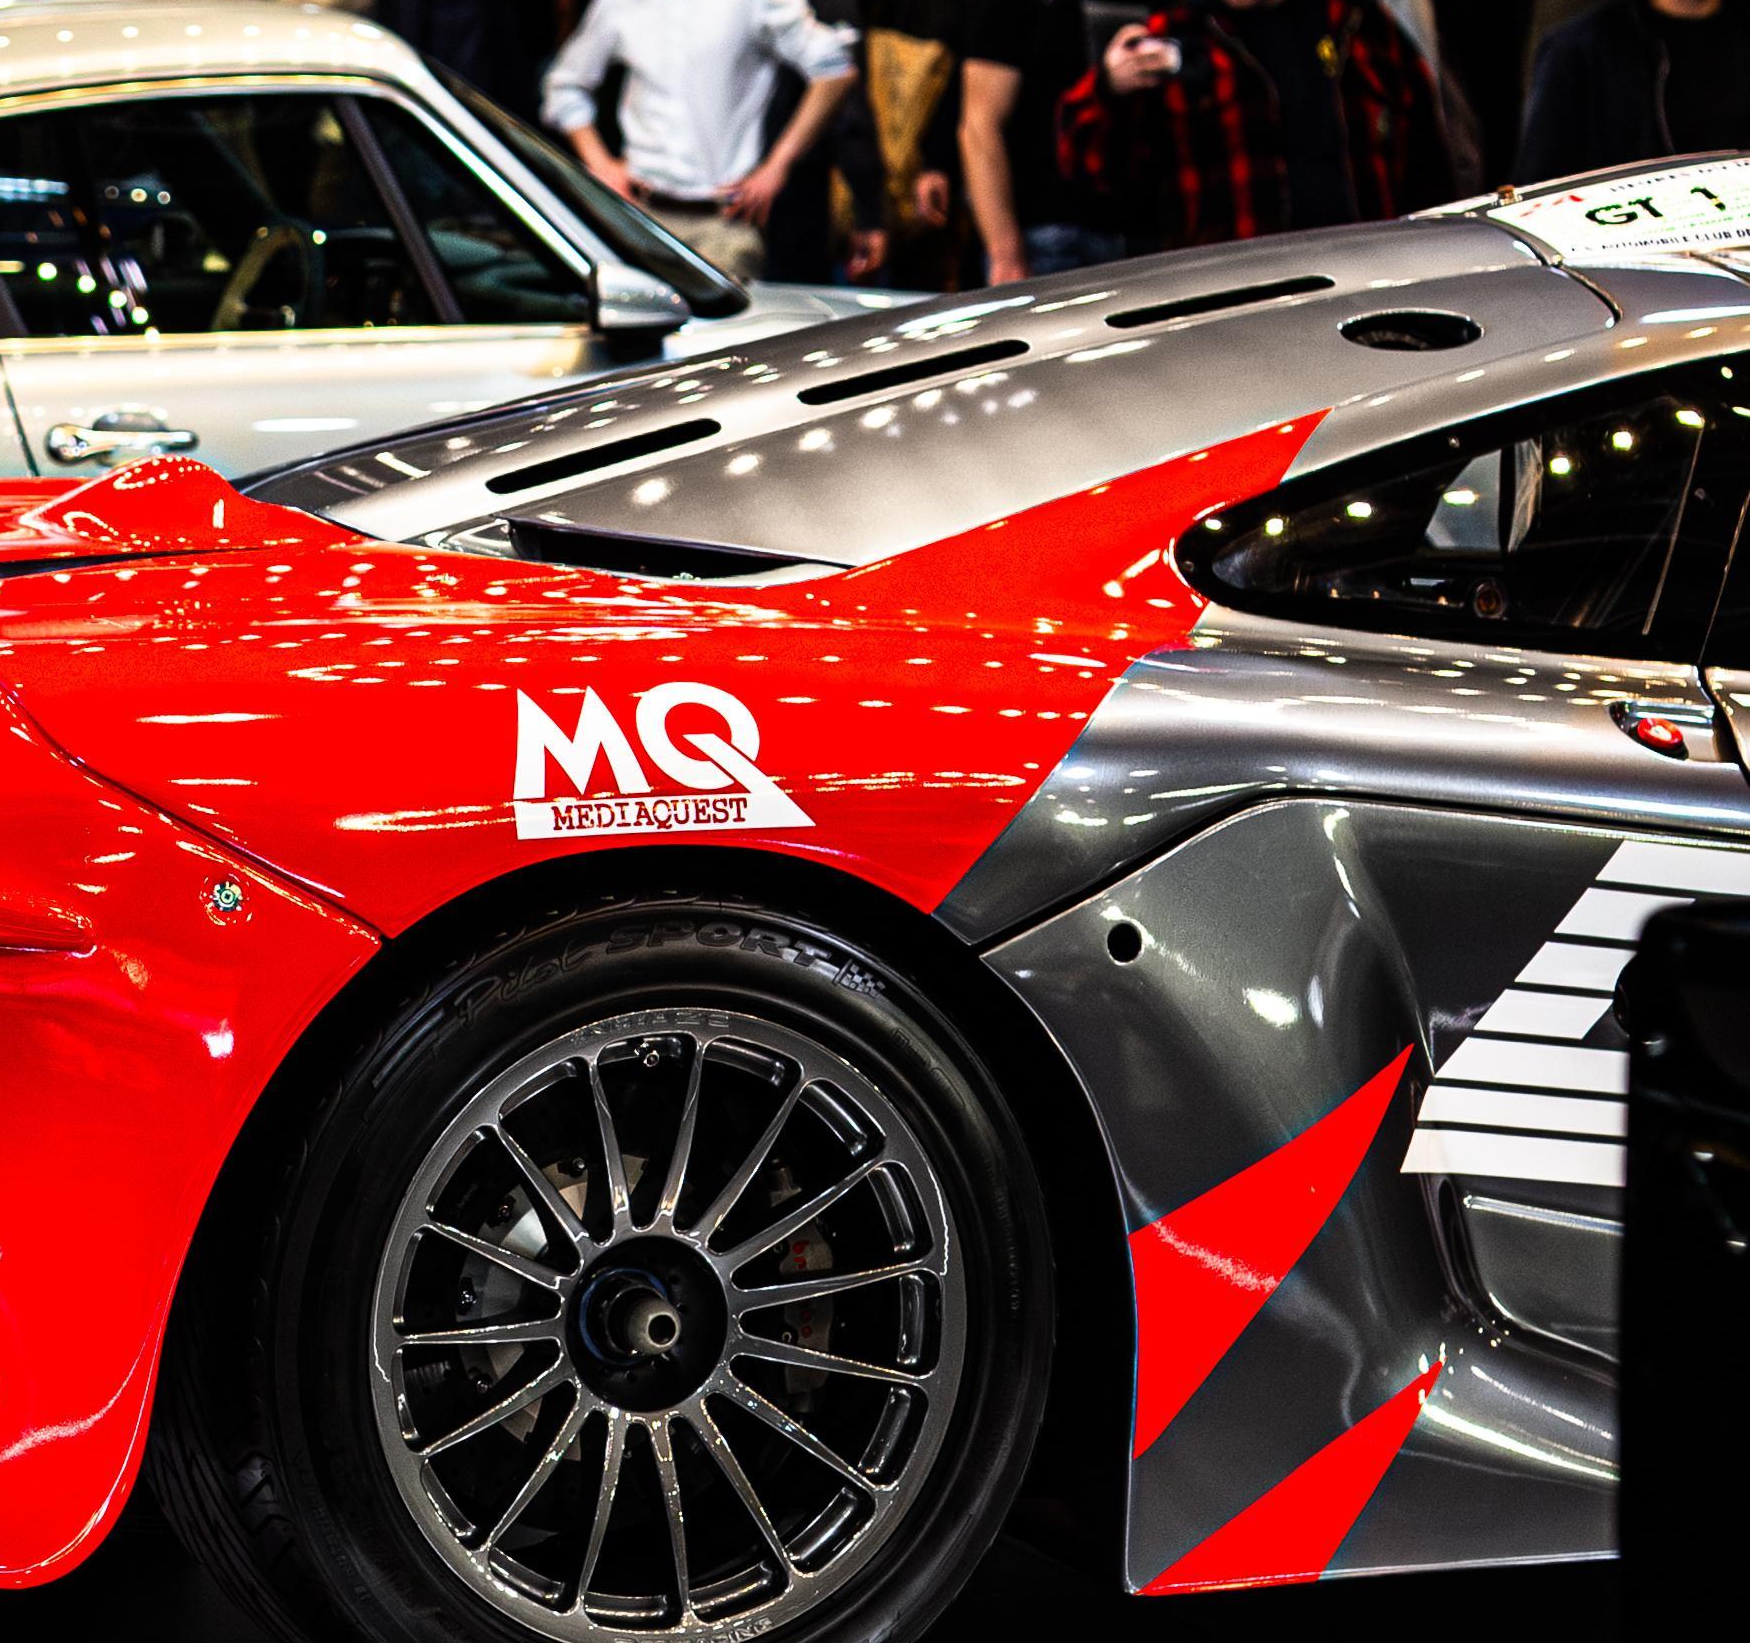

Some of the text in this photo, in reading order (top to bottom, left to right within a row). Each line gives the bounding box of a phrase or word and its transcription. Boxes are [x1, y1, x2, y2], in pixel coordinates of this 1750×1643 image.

[1585, 195, 1664, 225] GT
[513, 681, 792, 799] MQ
[552, 797, 748, 831] MEDIAQUEST
[453, 919, 832, 1029] Pilot SPORT
